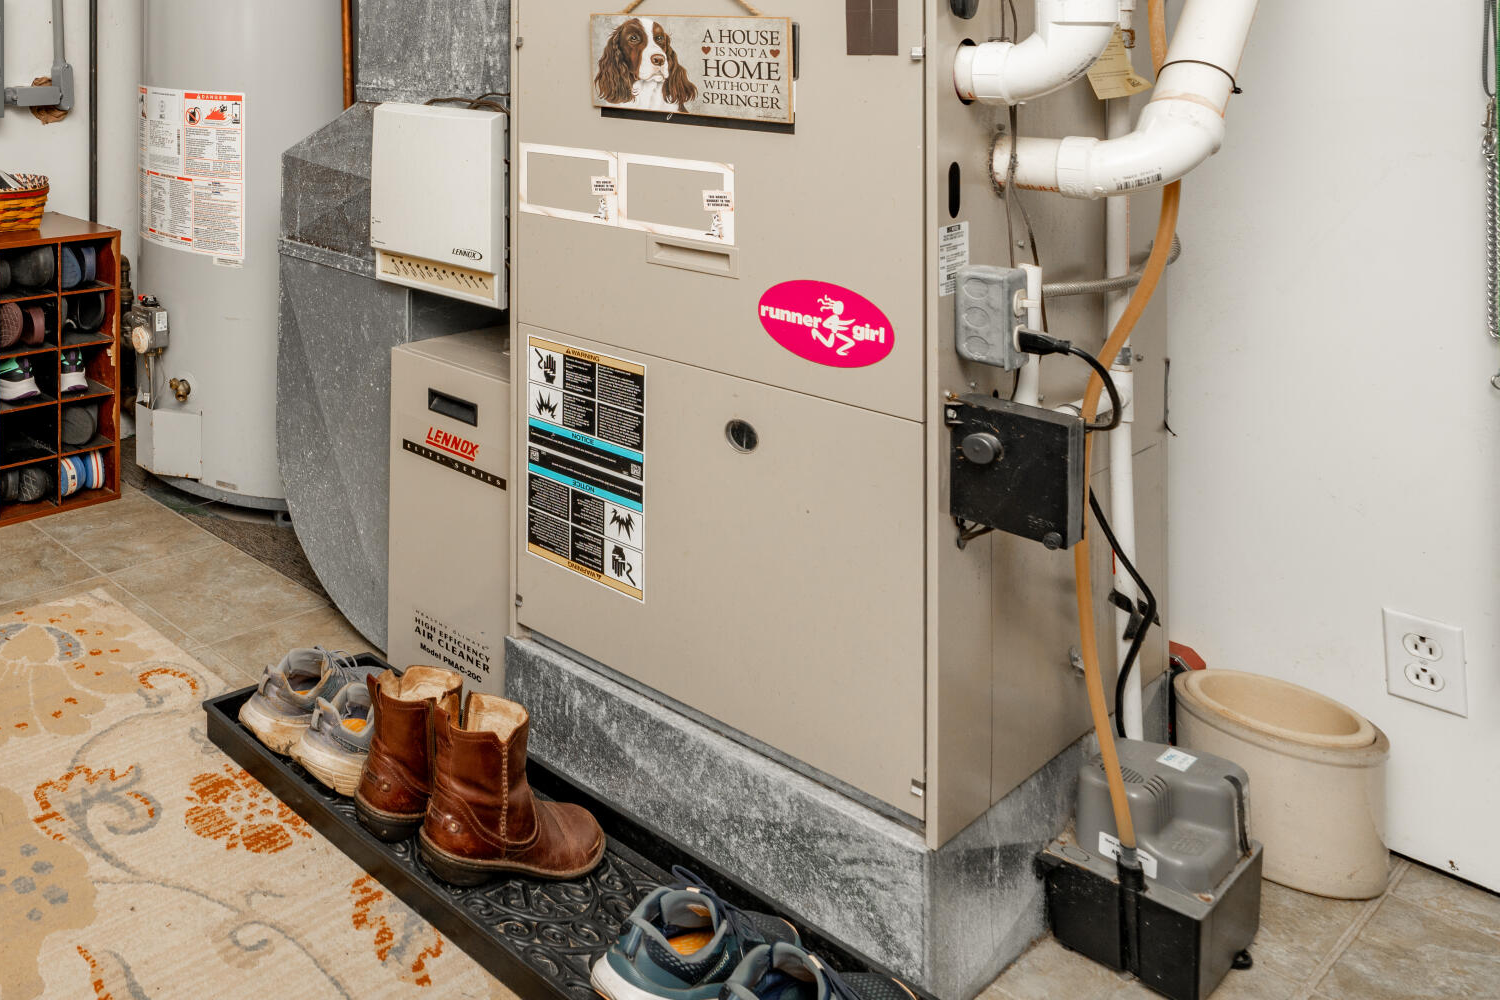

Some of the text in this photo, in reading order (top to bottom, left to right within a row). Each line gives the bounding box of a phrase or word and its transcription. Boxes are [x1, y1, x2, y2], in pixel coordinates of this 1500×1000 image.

[702, 28, 780, 46] A HOUSE
[715, 47, 768, 58] IS NOT A
[702, 58, 780, 81] HOME
[704, 80, 780, 94] WITHOUT A
[702, 92, 781, 110] SPRINGER
[452, 248, 476, 259] LENNOX
[760, 304, 885, 344] runner girl
[571, 348, 600, 362] WARNING
[426, 426, 480, 457] LENNOX
[572, 433, 595, 445] NOTICE
[454, 462, 501, 485] SERIES
[572, 479, 595, 493] NOTICE
[567, 560, 596, 578] WARNING
[414, 617, 490, 662] HIGH EFFICIENCY
[414, 626, 490, 674] AIR CLEANER
[420, 642, 482, 683] Model PMAC-20C
